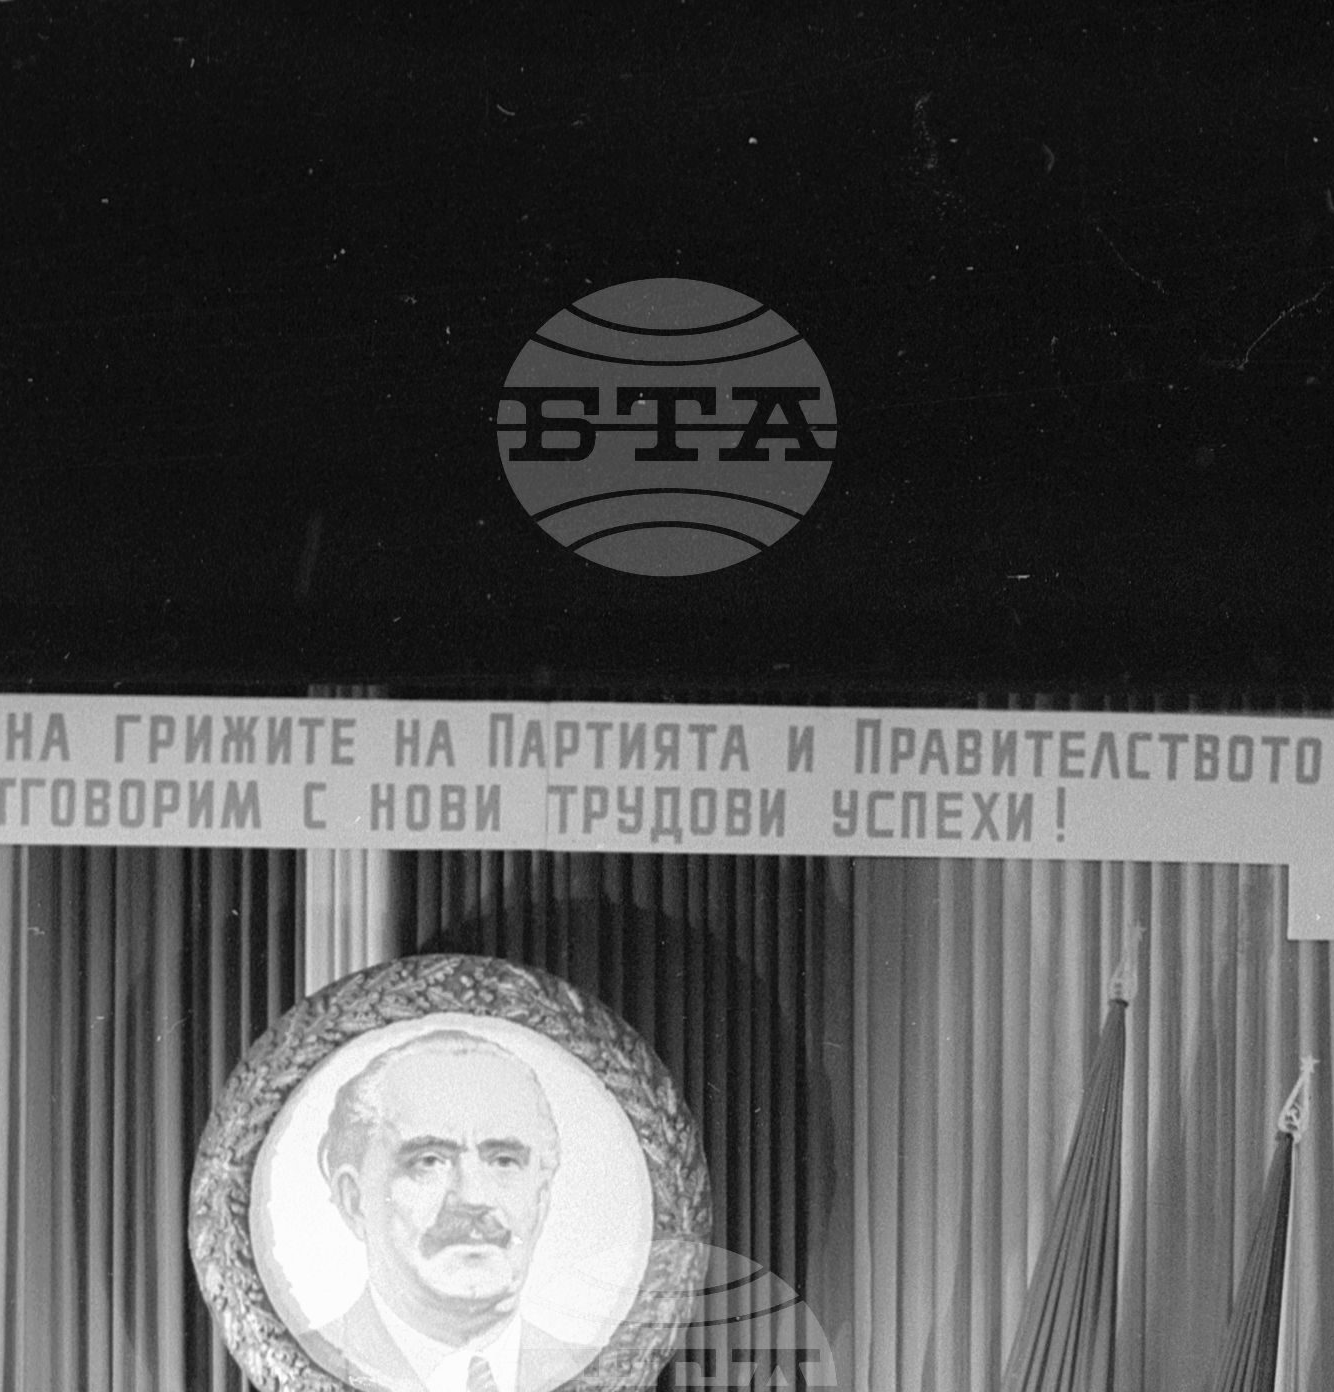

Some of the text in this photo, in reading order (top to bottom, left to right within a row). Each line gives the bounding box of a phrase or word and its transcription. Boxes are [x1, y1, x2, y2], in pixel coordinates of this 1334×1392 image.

[6, 712, 71, 761] НА
[113, 713, 356, 767] ГРИЖИТЕ
[396, 718, 456, 769] НА
[488, 713, 750, 773] ПАРТИЯТА
[788, 724, 816, 774] И
[303, 781, 328, 831] С
[370, 782, 503, 834] НОВИ
[547, 784, 787, 844] ТРУДОВИ
[831, 787, 1069, 844] УСПЕХИ!
